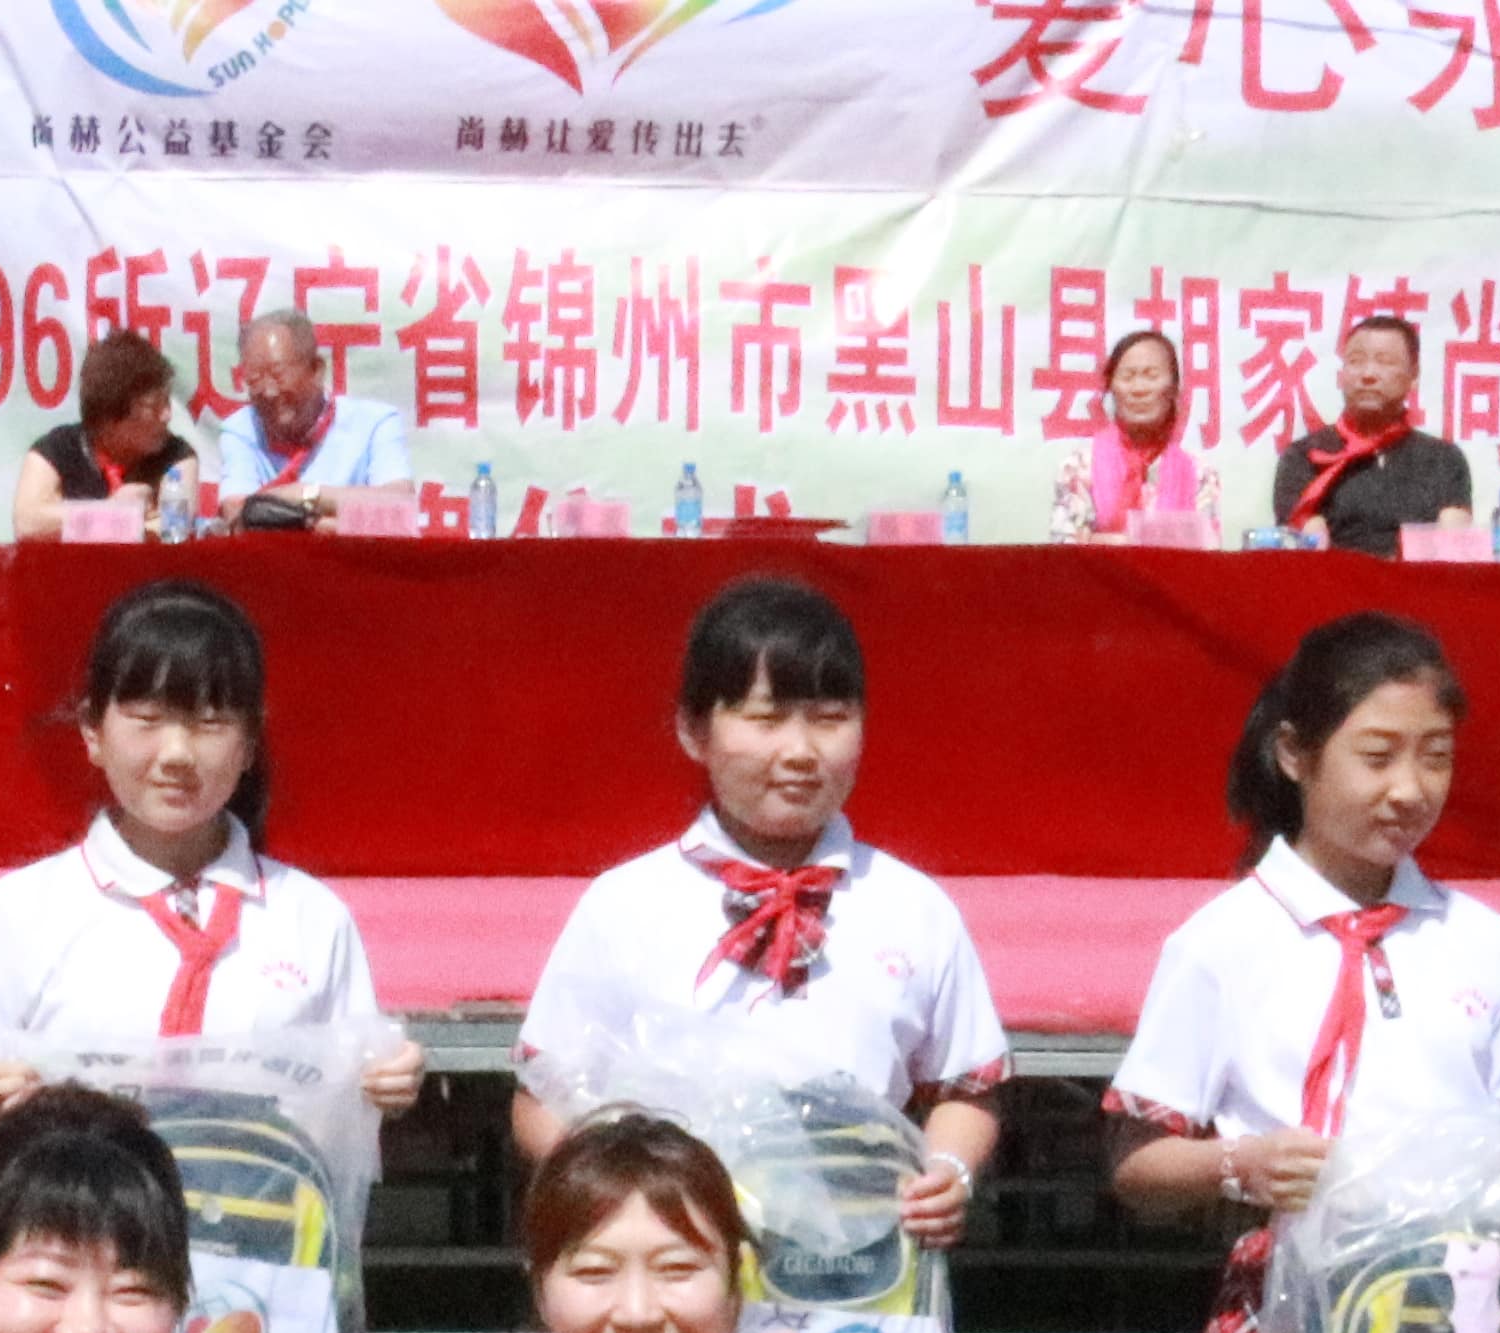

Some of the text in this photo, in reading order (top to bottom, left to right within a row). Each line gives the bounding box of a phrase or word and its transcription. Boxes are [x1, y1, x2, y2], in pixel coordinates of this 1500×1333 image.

[31, 112, 333, 159] 尚赫公益基金会
[456, 115, 746, 158] 尚赫让爱传出去
